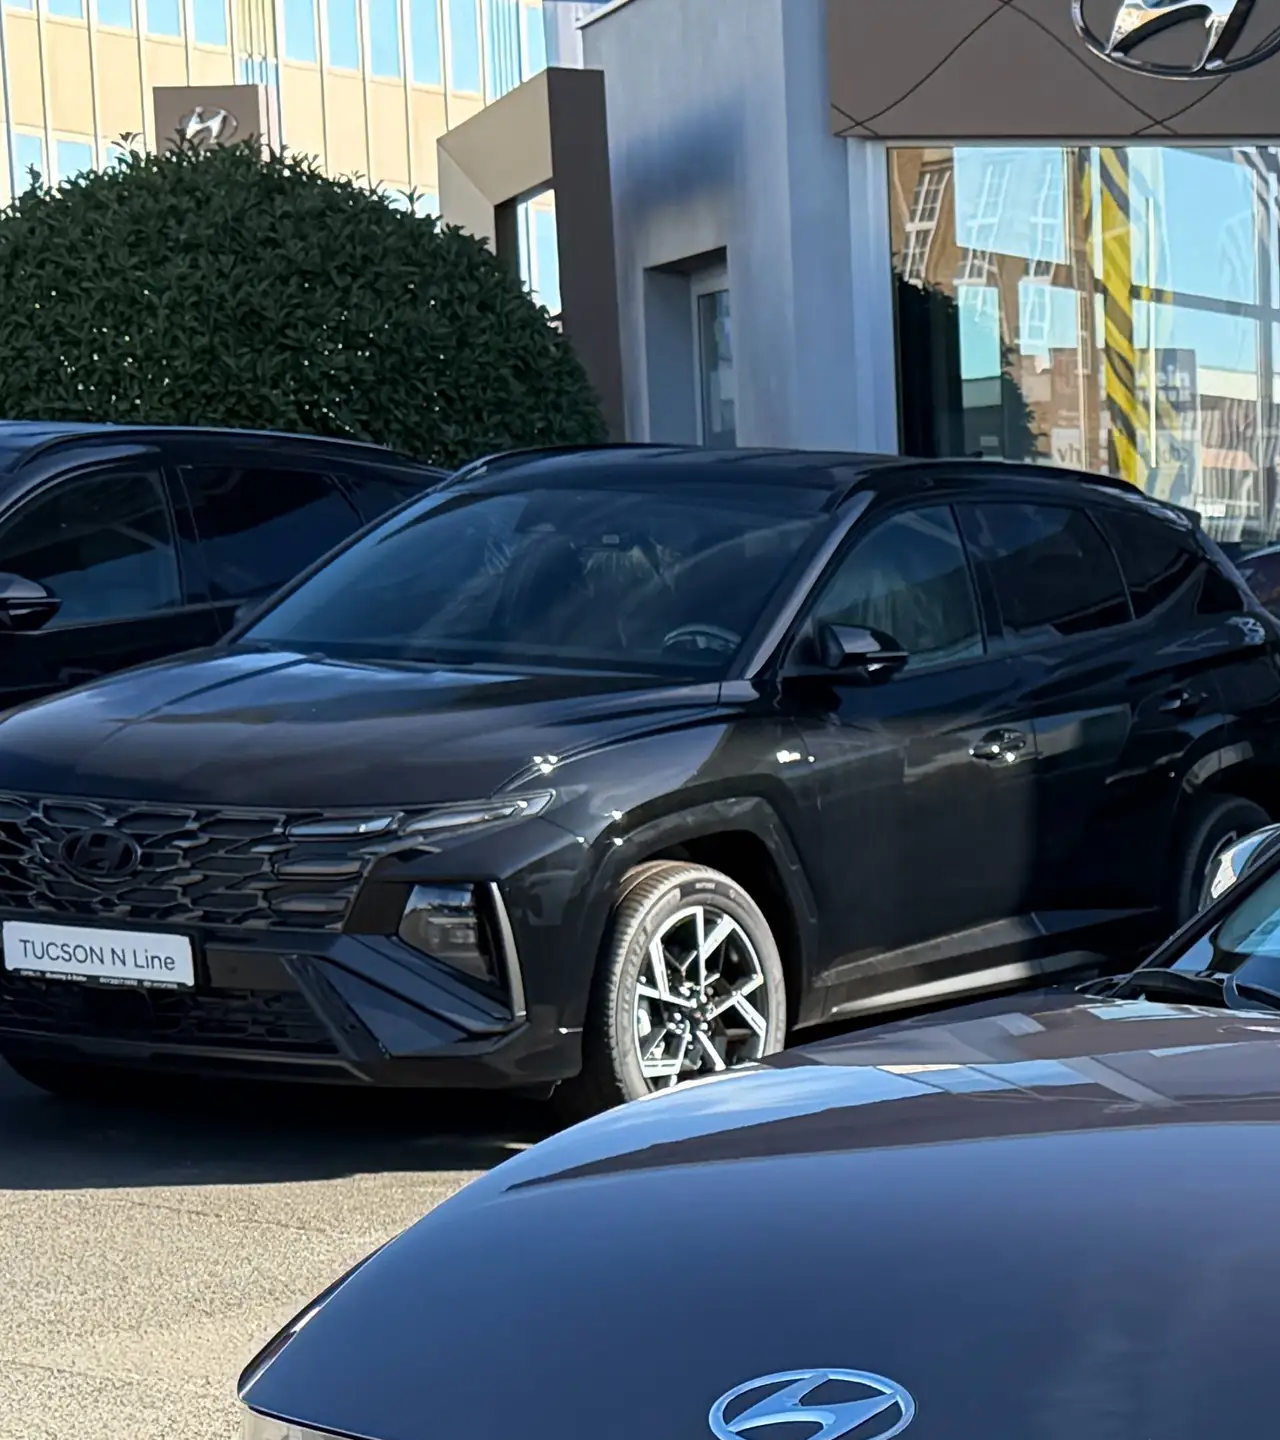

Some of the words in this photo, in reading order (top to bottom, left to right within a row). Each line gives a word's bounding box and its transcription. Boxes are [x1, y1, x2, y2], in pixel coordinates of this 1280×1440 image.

[18, 938, 105, 966] TUCSON
[111, 947, 127, 968] N
[133, 949, 176, 971] Line
